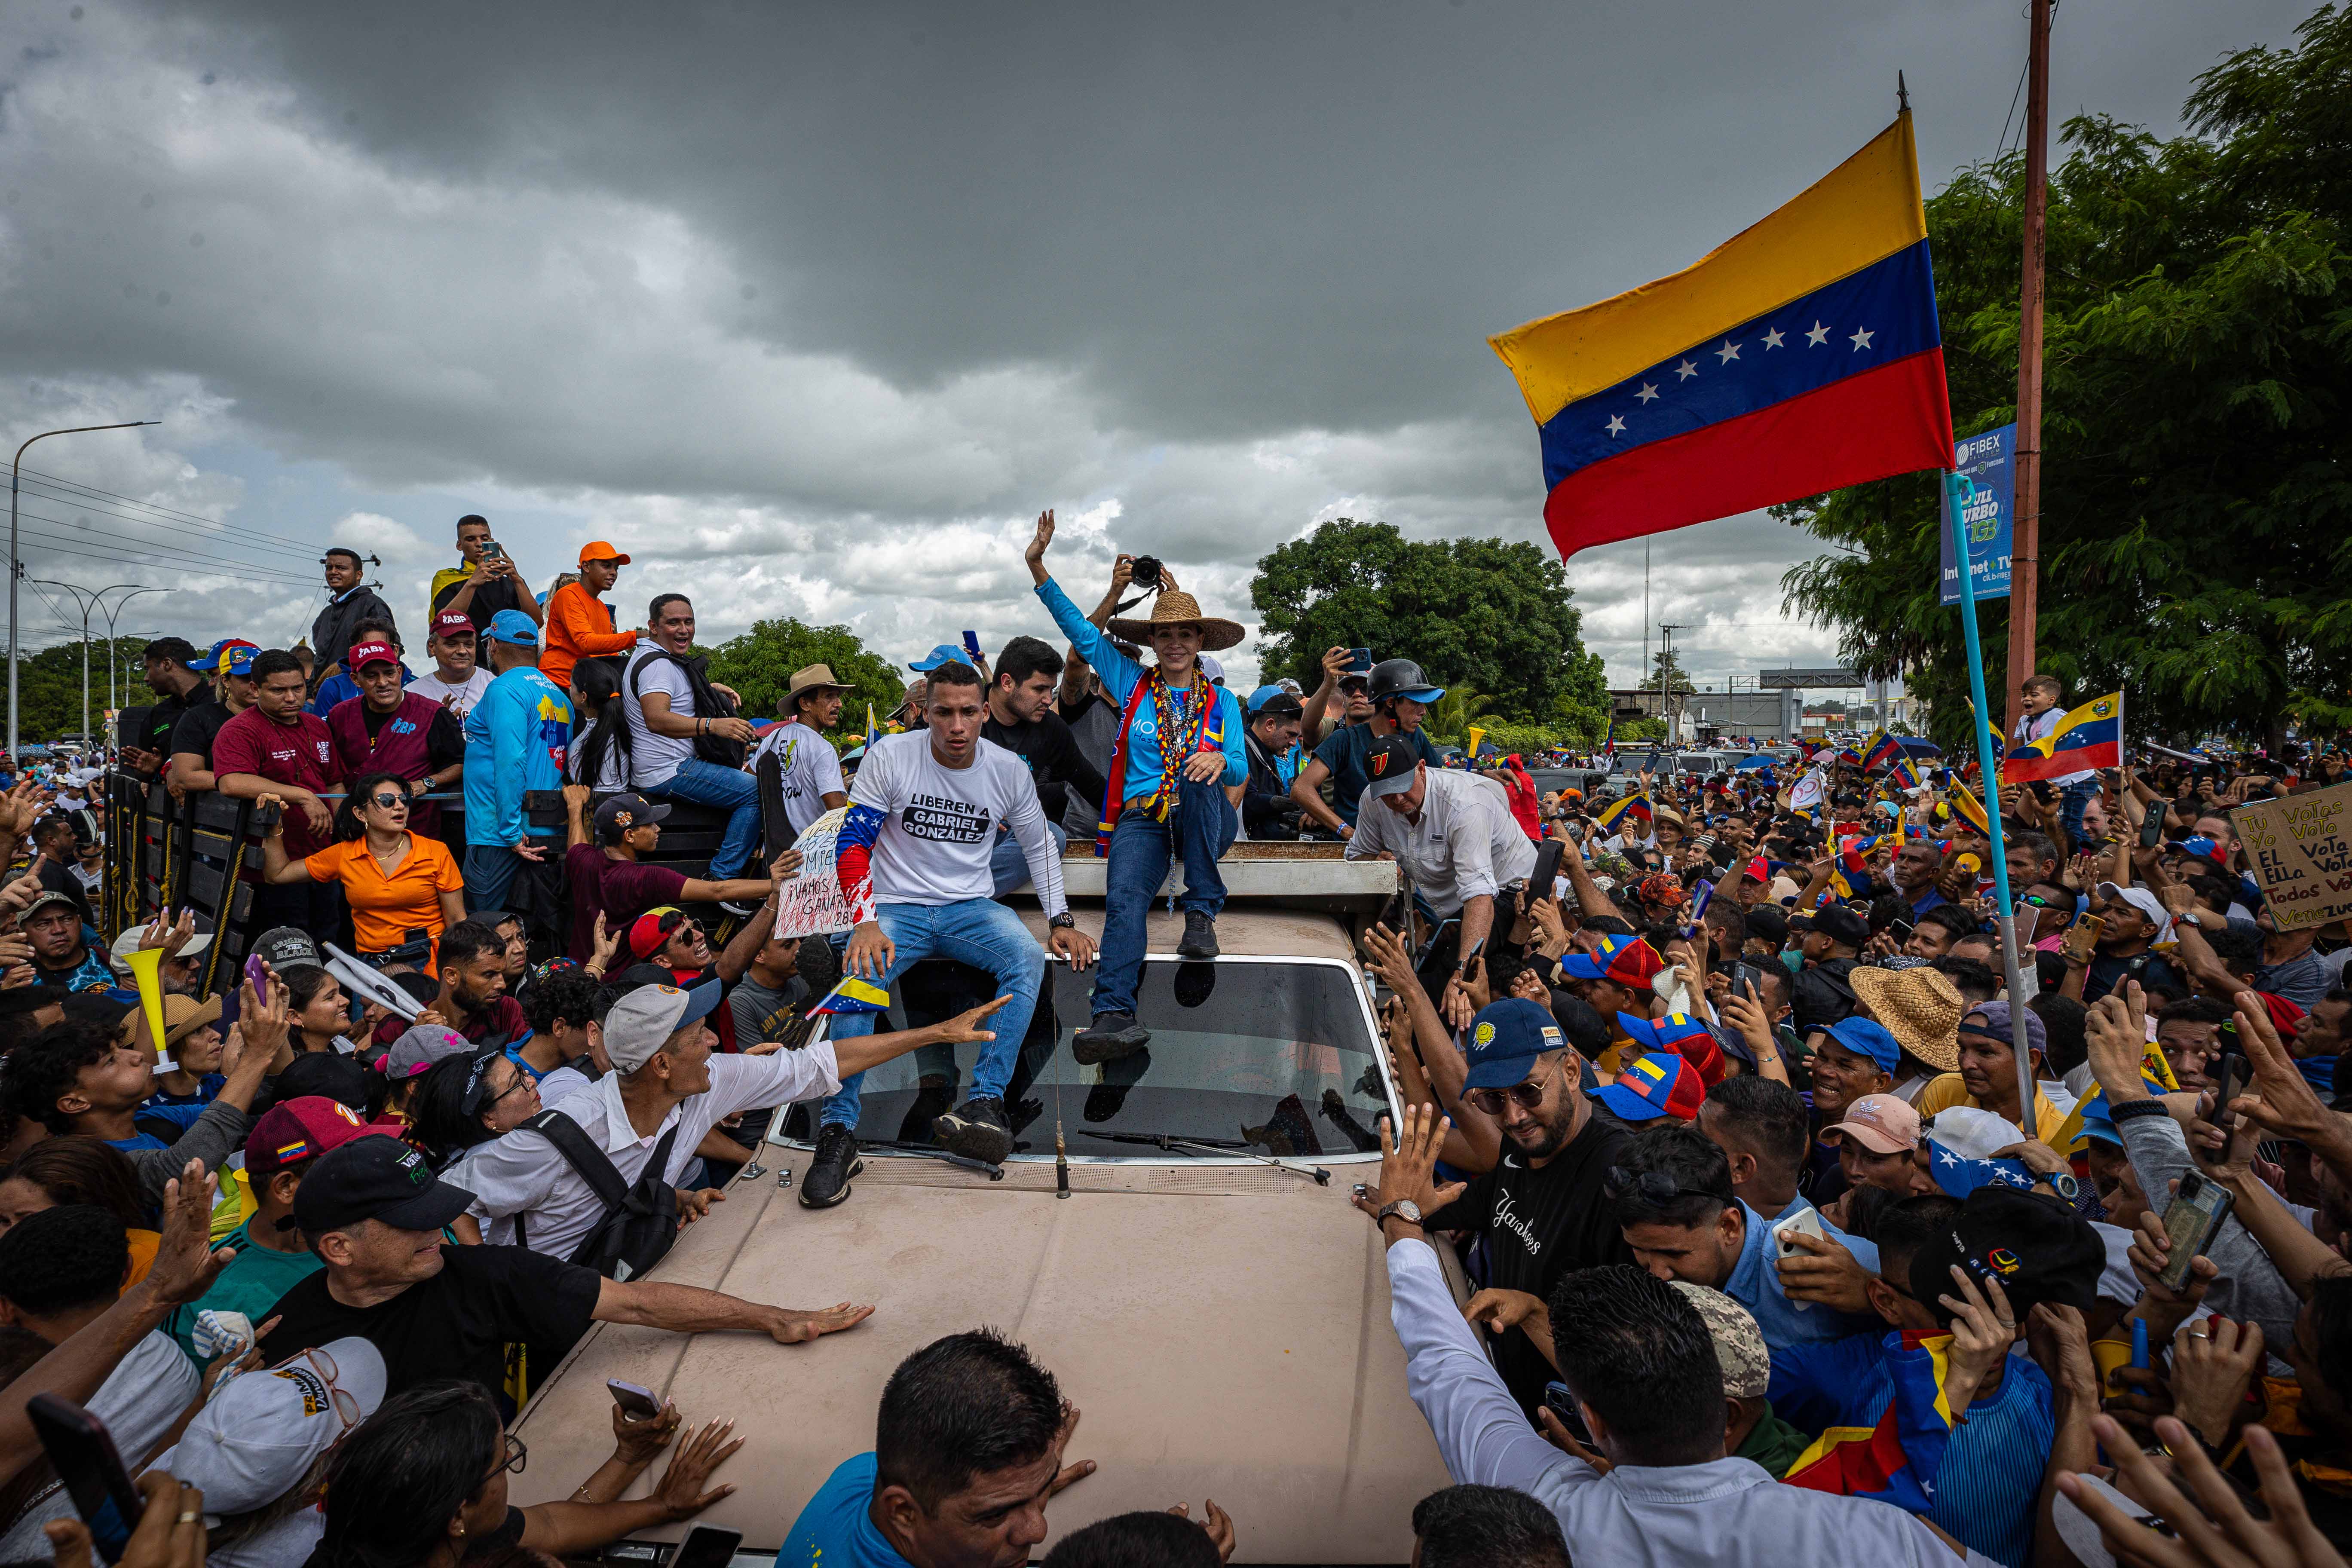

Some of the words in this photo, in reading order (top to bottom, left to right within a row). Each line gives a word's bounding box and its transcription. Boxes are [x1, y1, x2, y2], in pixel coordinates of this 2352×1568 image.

[1970, 434, 2000, 456] FIBEX
[1963, 501, 1998, 523] URBO
[1971, 518, 1997, 543] 1GB
[1945, 560, 1988, 580] Intnet
[448, 615, 467, 624] ABP
[363, 646, 385, 656] ABP
[910, 793, 976, 815] LIBEREN
[979, 807, 989, 819] A
[913, 811, 979, 831] GABRIEL
[903, 822, 984, 842] GONZÁLEZ
[2263, 884, 2320, 905] Todos
[276, 948, 313, 959] BLACK
[1853, 1112, 1877, 1122] adidas
[1493, 1188, 1540, 1255] Yankees
[1952, 1231, 1965, 1253] pana
